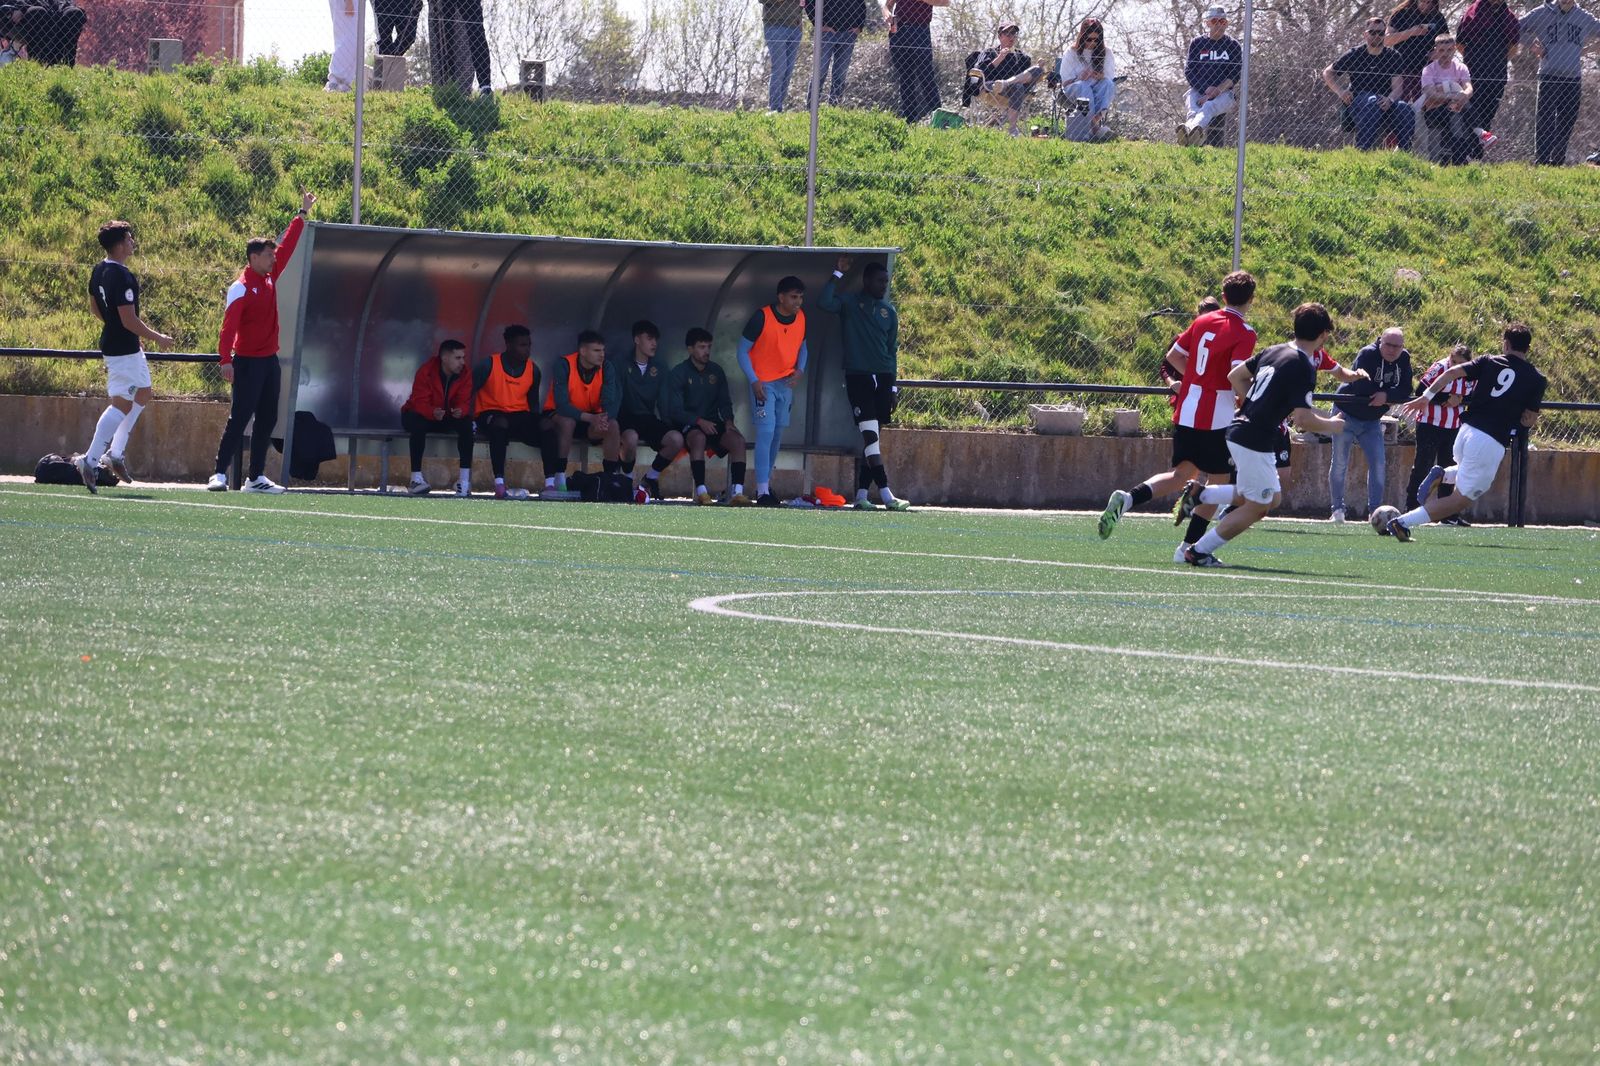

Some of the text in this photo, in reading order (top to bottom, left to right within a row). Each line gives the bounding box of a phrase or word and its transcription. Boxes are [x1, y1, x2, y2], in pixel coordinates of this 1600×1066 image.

[1200, 50, 1229, 60] FILA
[1195, 331, 1216, 376] 6
[1490, 368, 1516, 398] 9
